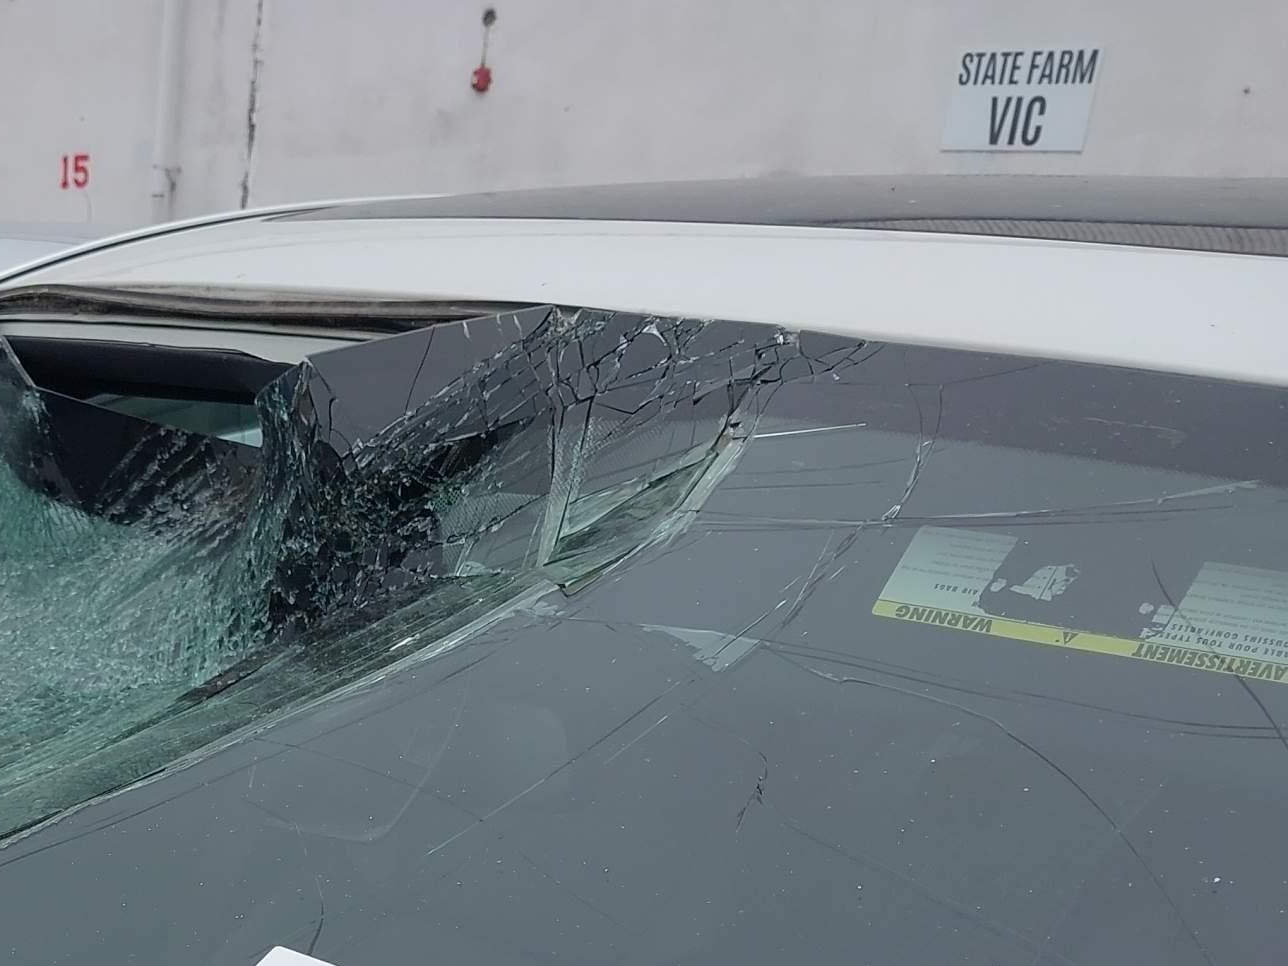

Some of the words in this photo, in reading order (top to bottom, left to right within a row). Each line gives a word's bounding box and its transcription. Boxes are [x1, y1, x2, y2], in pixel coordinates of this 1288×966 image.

[958, 51, 1024, 86] STATE
[1027, 49, 1100, 85] FARM
[988, 95, 1047, 146] VIC
[60, 154, 90, 190] 15
[895, 604, 993, 633] WARNING
[1195, 636, 1224, 650] TOUS
[1228, 641, 1259, 654] POUR
[1131, 642, 1288, 681] AVERTISSEMENT
